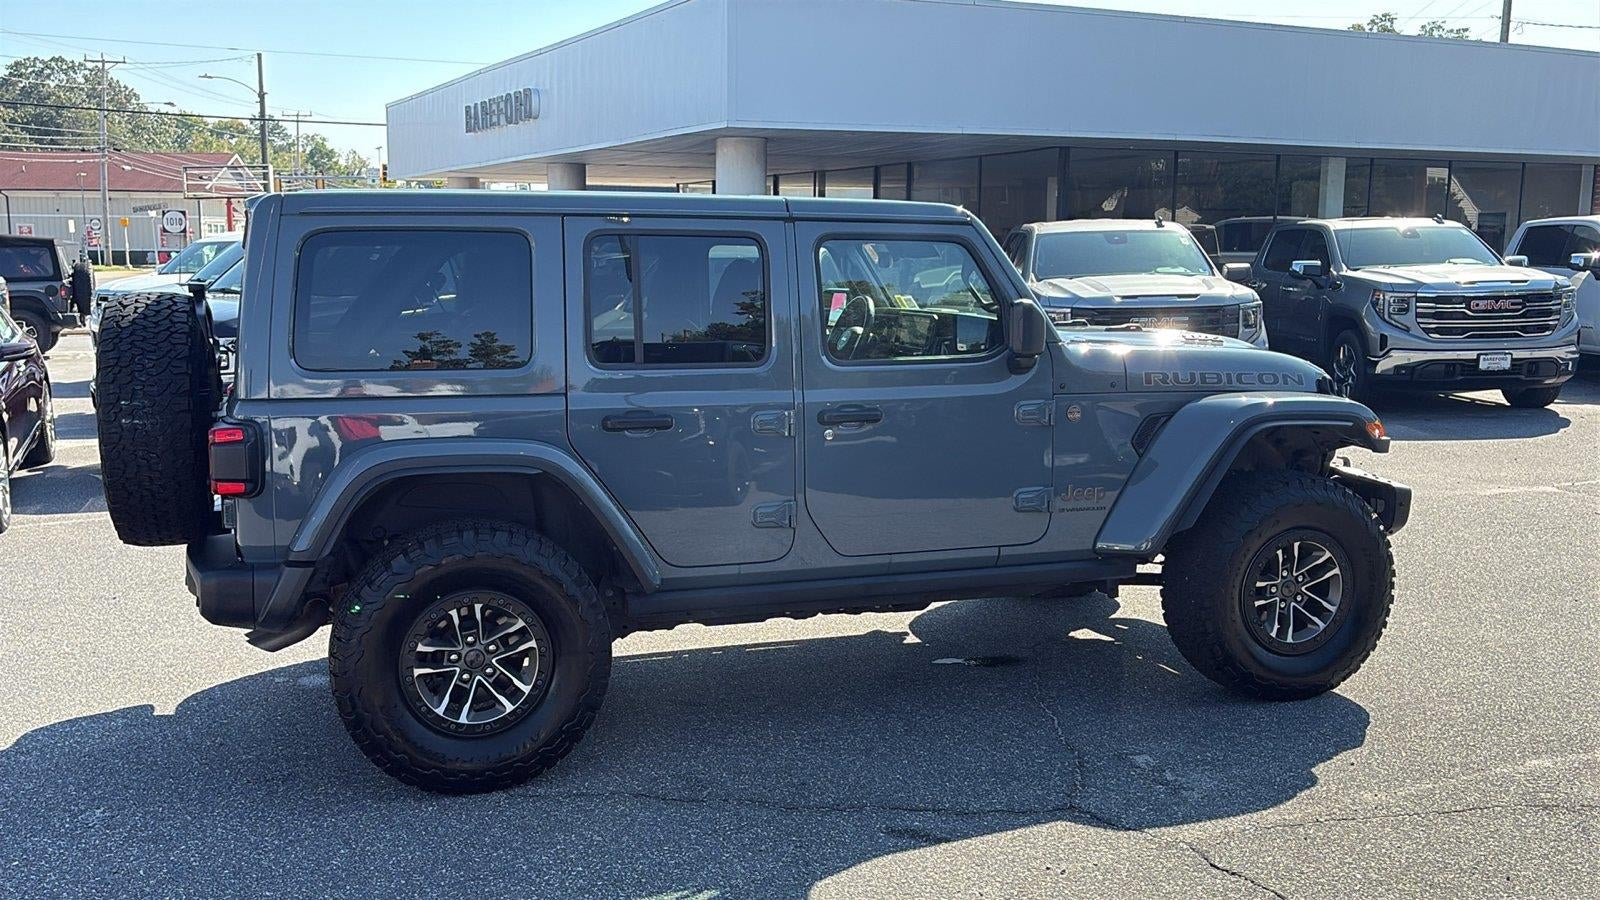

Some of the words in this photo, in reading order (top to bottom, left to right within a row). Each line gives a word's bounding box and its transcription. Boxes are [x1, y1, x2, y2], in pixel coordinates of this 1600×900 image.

[464, 87, 539, 133] BAREFORD
[166, 217, 183, 226] 1010
[1470, 298, 1523, 310] GMC
[1129, 316, 1190, 329] GMC
[1142, 371, 1305, 387] RUBICON
[1060, 483, 1105, 504] Jeep
